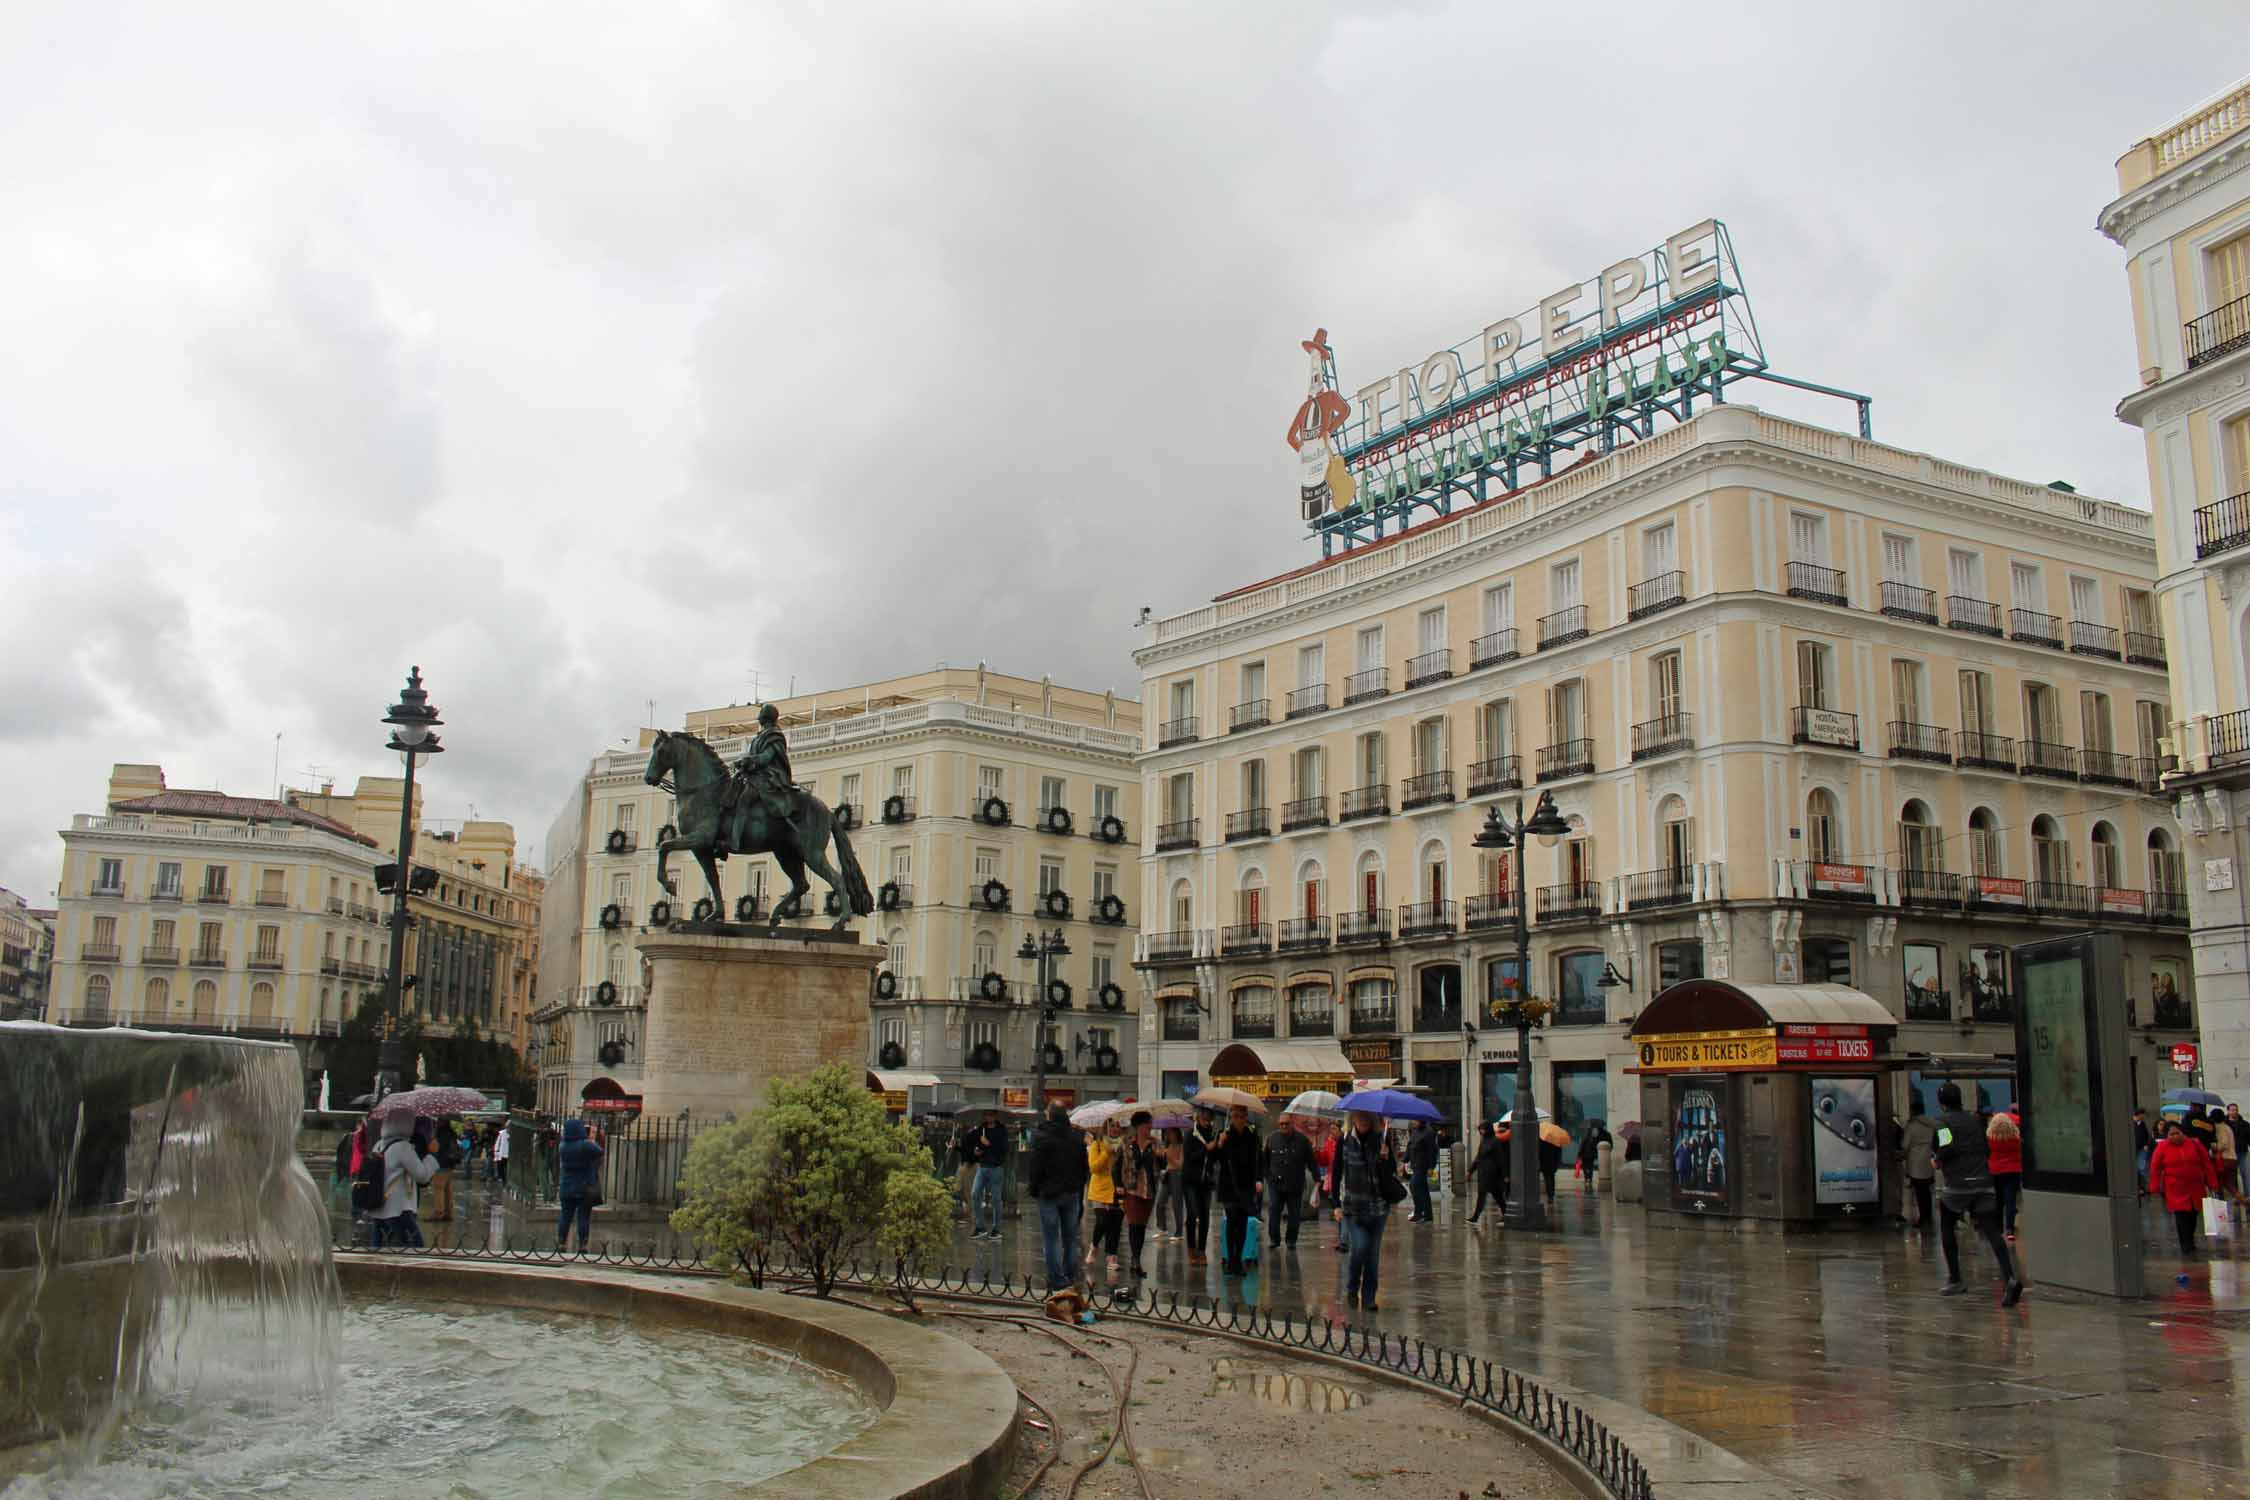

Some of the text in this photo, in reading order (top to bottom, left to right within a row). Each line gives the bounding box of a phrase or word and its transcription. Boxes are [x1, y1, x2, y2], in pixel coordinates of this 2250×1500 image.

[1357, 217, 1717, 437] TIO PEPE
[1355, 445, 1393, 471] SOL
[1396, 430, 1420, 455] DE
[1544, 297, 1718, 389] EMBOTELLADO
[1586, 329, 1727, 422] BYASS
[1815, 712, 1839, 724] HOSTAL
[1813, 722, 1850, 736] AMERICANO
[1656, 1045, 1689, 1062] TOURS
[1691, 1044, 1700, 1061] &
[1703, 1042, 1749, 1061] TICKETS
[1836, 1039, 1869, 1057] TICKETS
